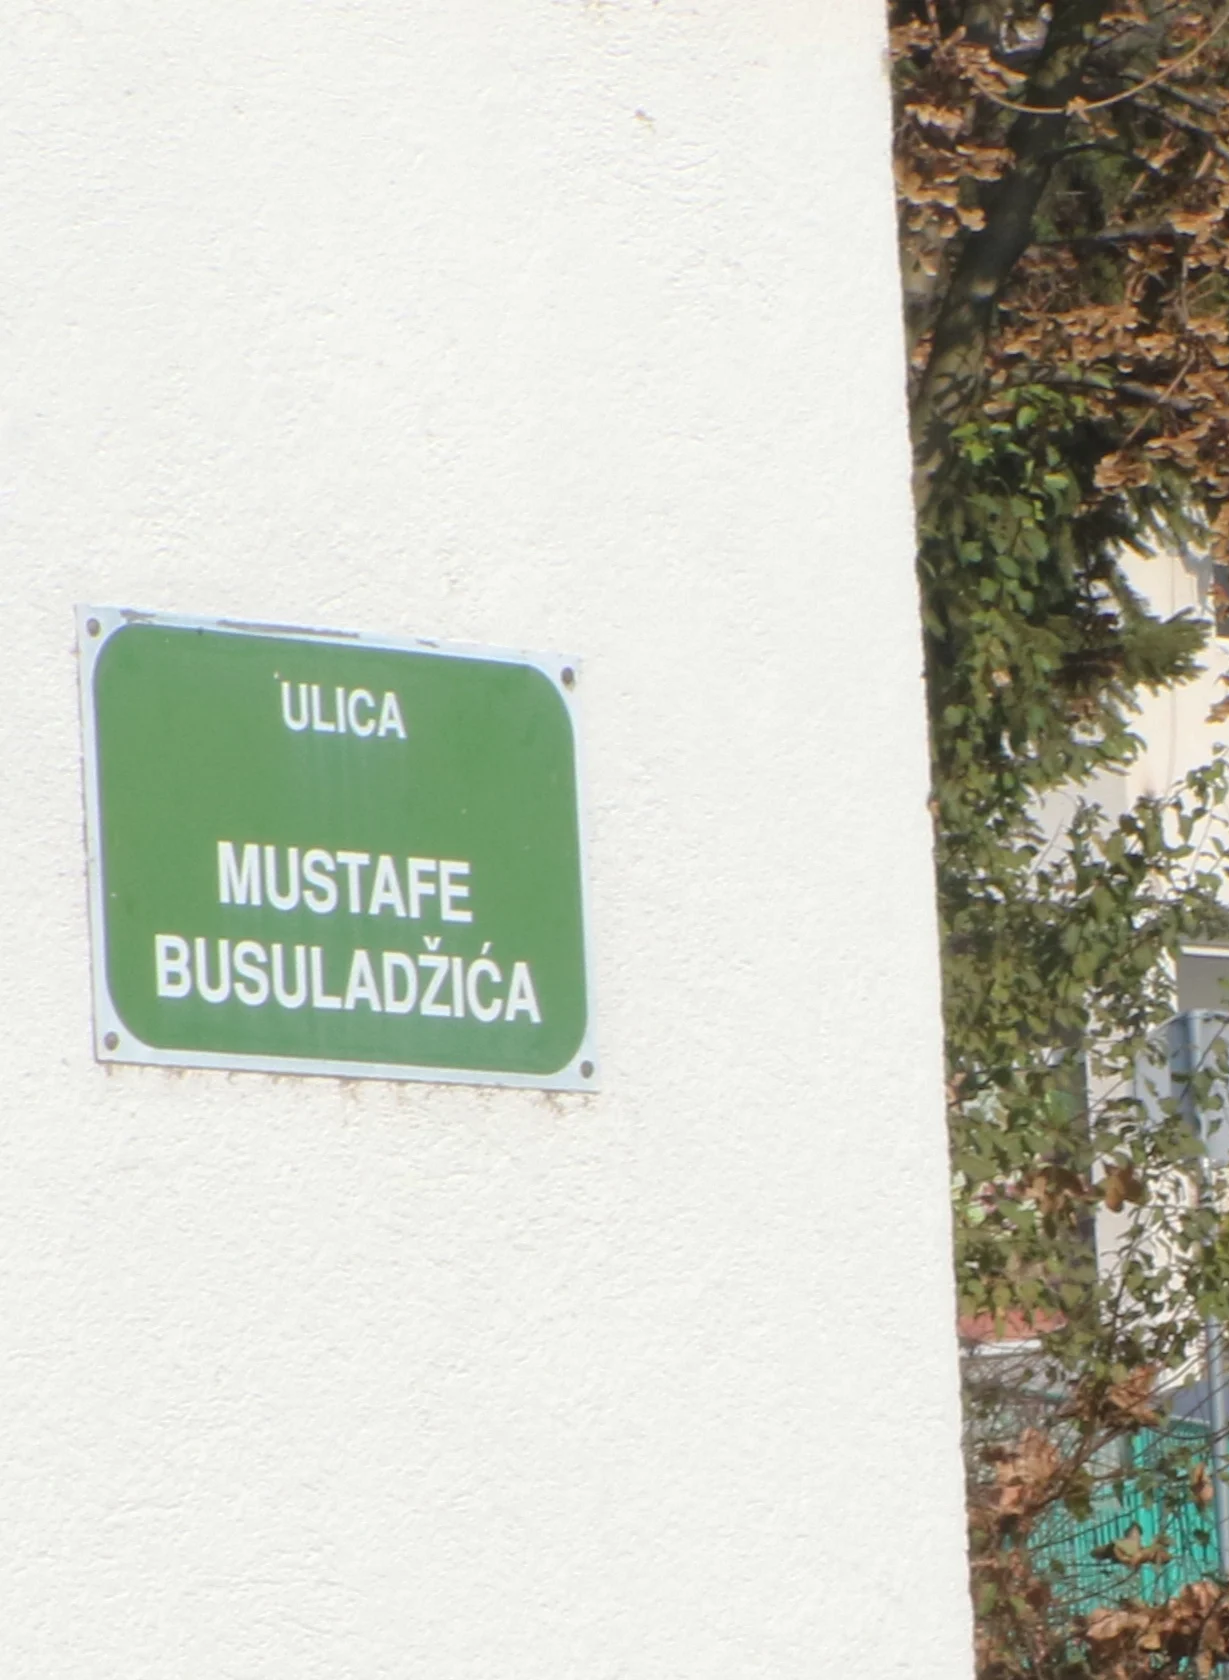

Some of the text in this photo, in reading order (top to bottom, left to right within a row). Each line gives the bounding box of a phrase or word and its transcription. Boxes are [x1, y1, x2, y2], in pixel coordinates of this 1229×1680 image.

[281, 681, 407, 738] ULICA
[217, 841, 473, 922] MUSTAFE
[154, 934, 541, 1023] BUSULADŽIĆA
